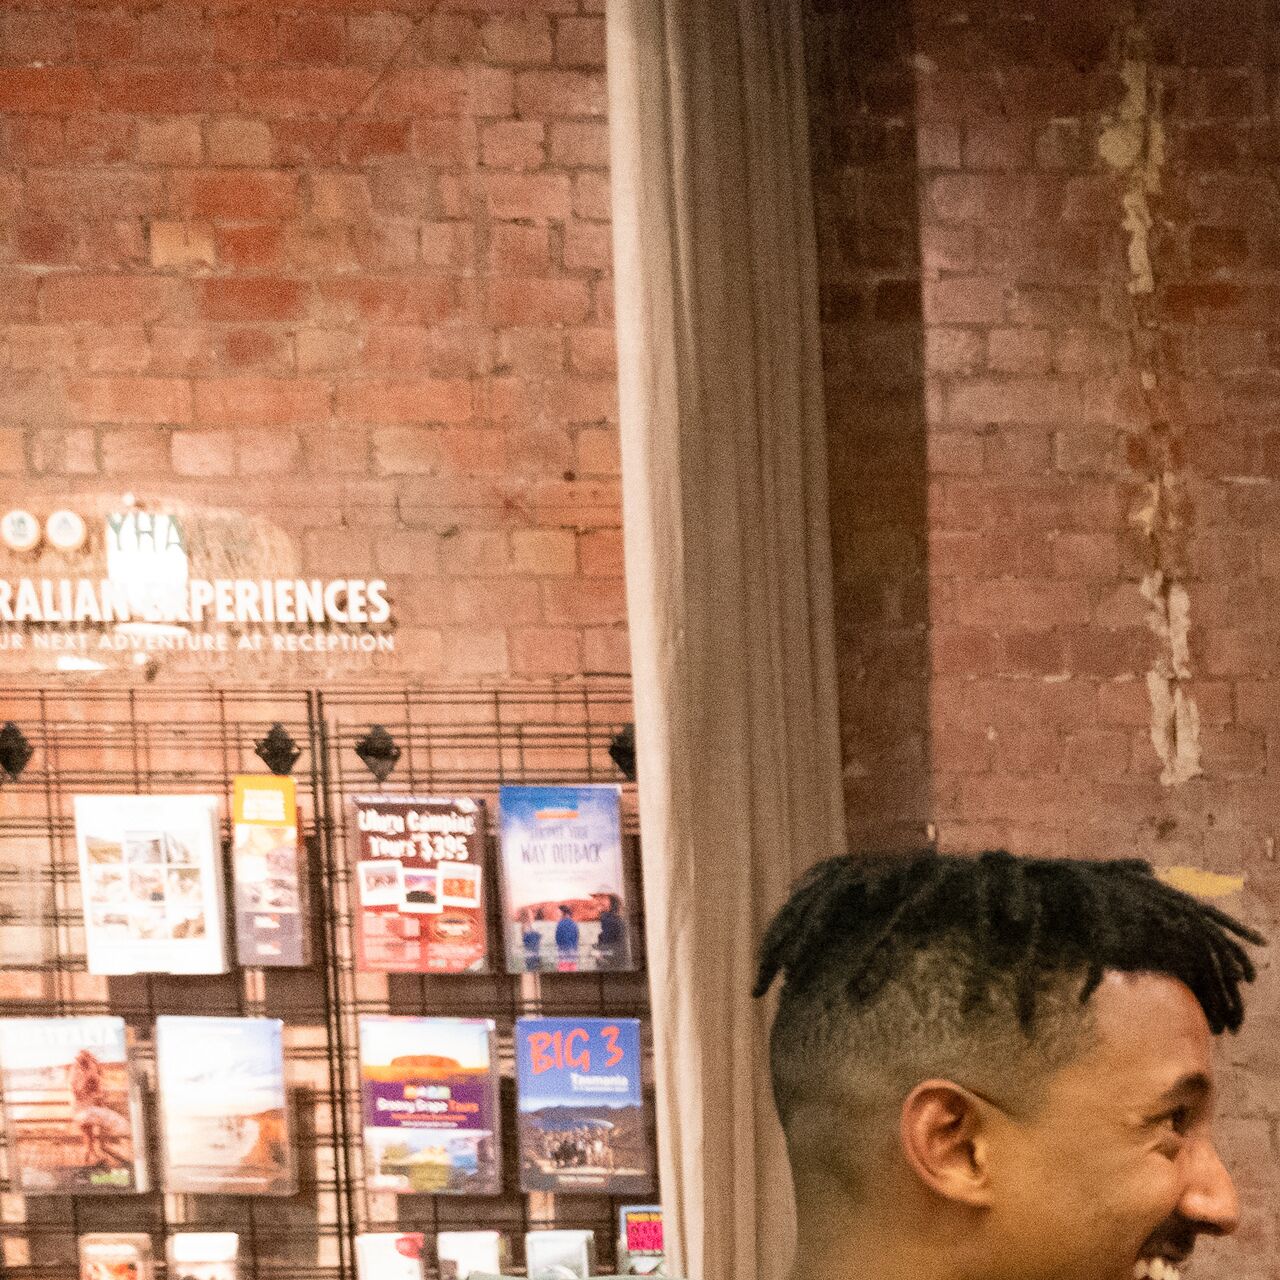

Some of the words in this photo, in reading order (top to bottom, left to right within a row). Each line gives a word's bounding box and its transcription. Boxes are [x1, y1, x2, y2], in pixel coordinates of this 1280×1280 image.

[34, 635, 87, 651] NEXT
[100, 634, 228, 651] ADVENTURE
[236, 634, 264, 651] AT
[272, 633, 395, 652] RECEPTION
[527, 1028, 590, 1074] BIG
[601, 1025, 623, 1067] 3
